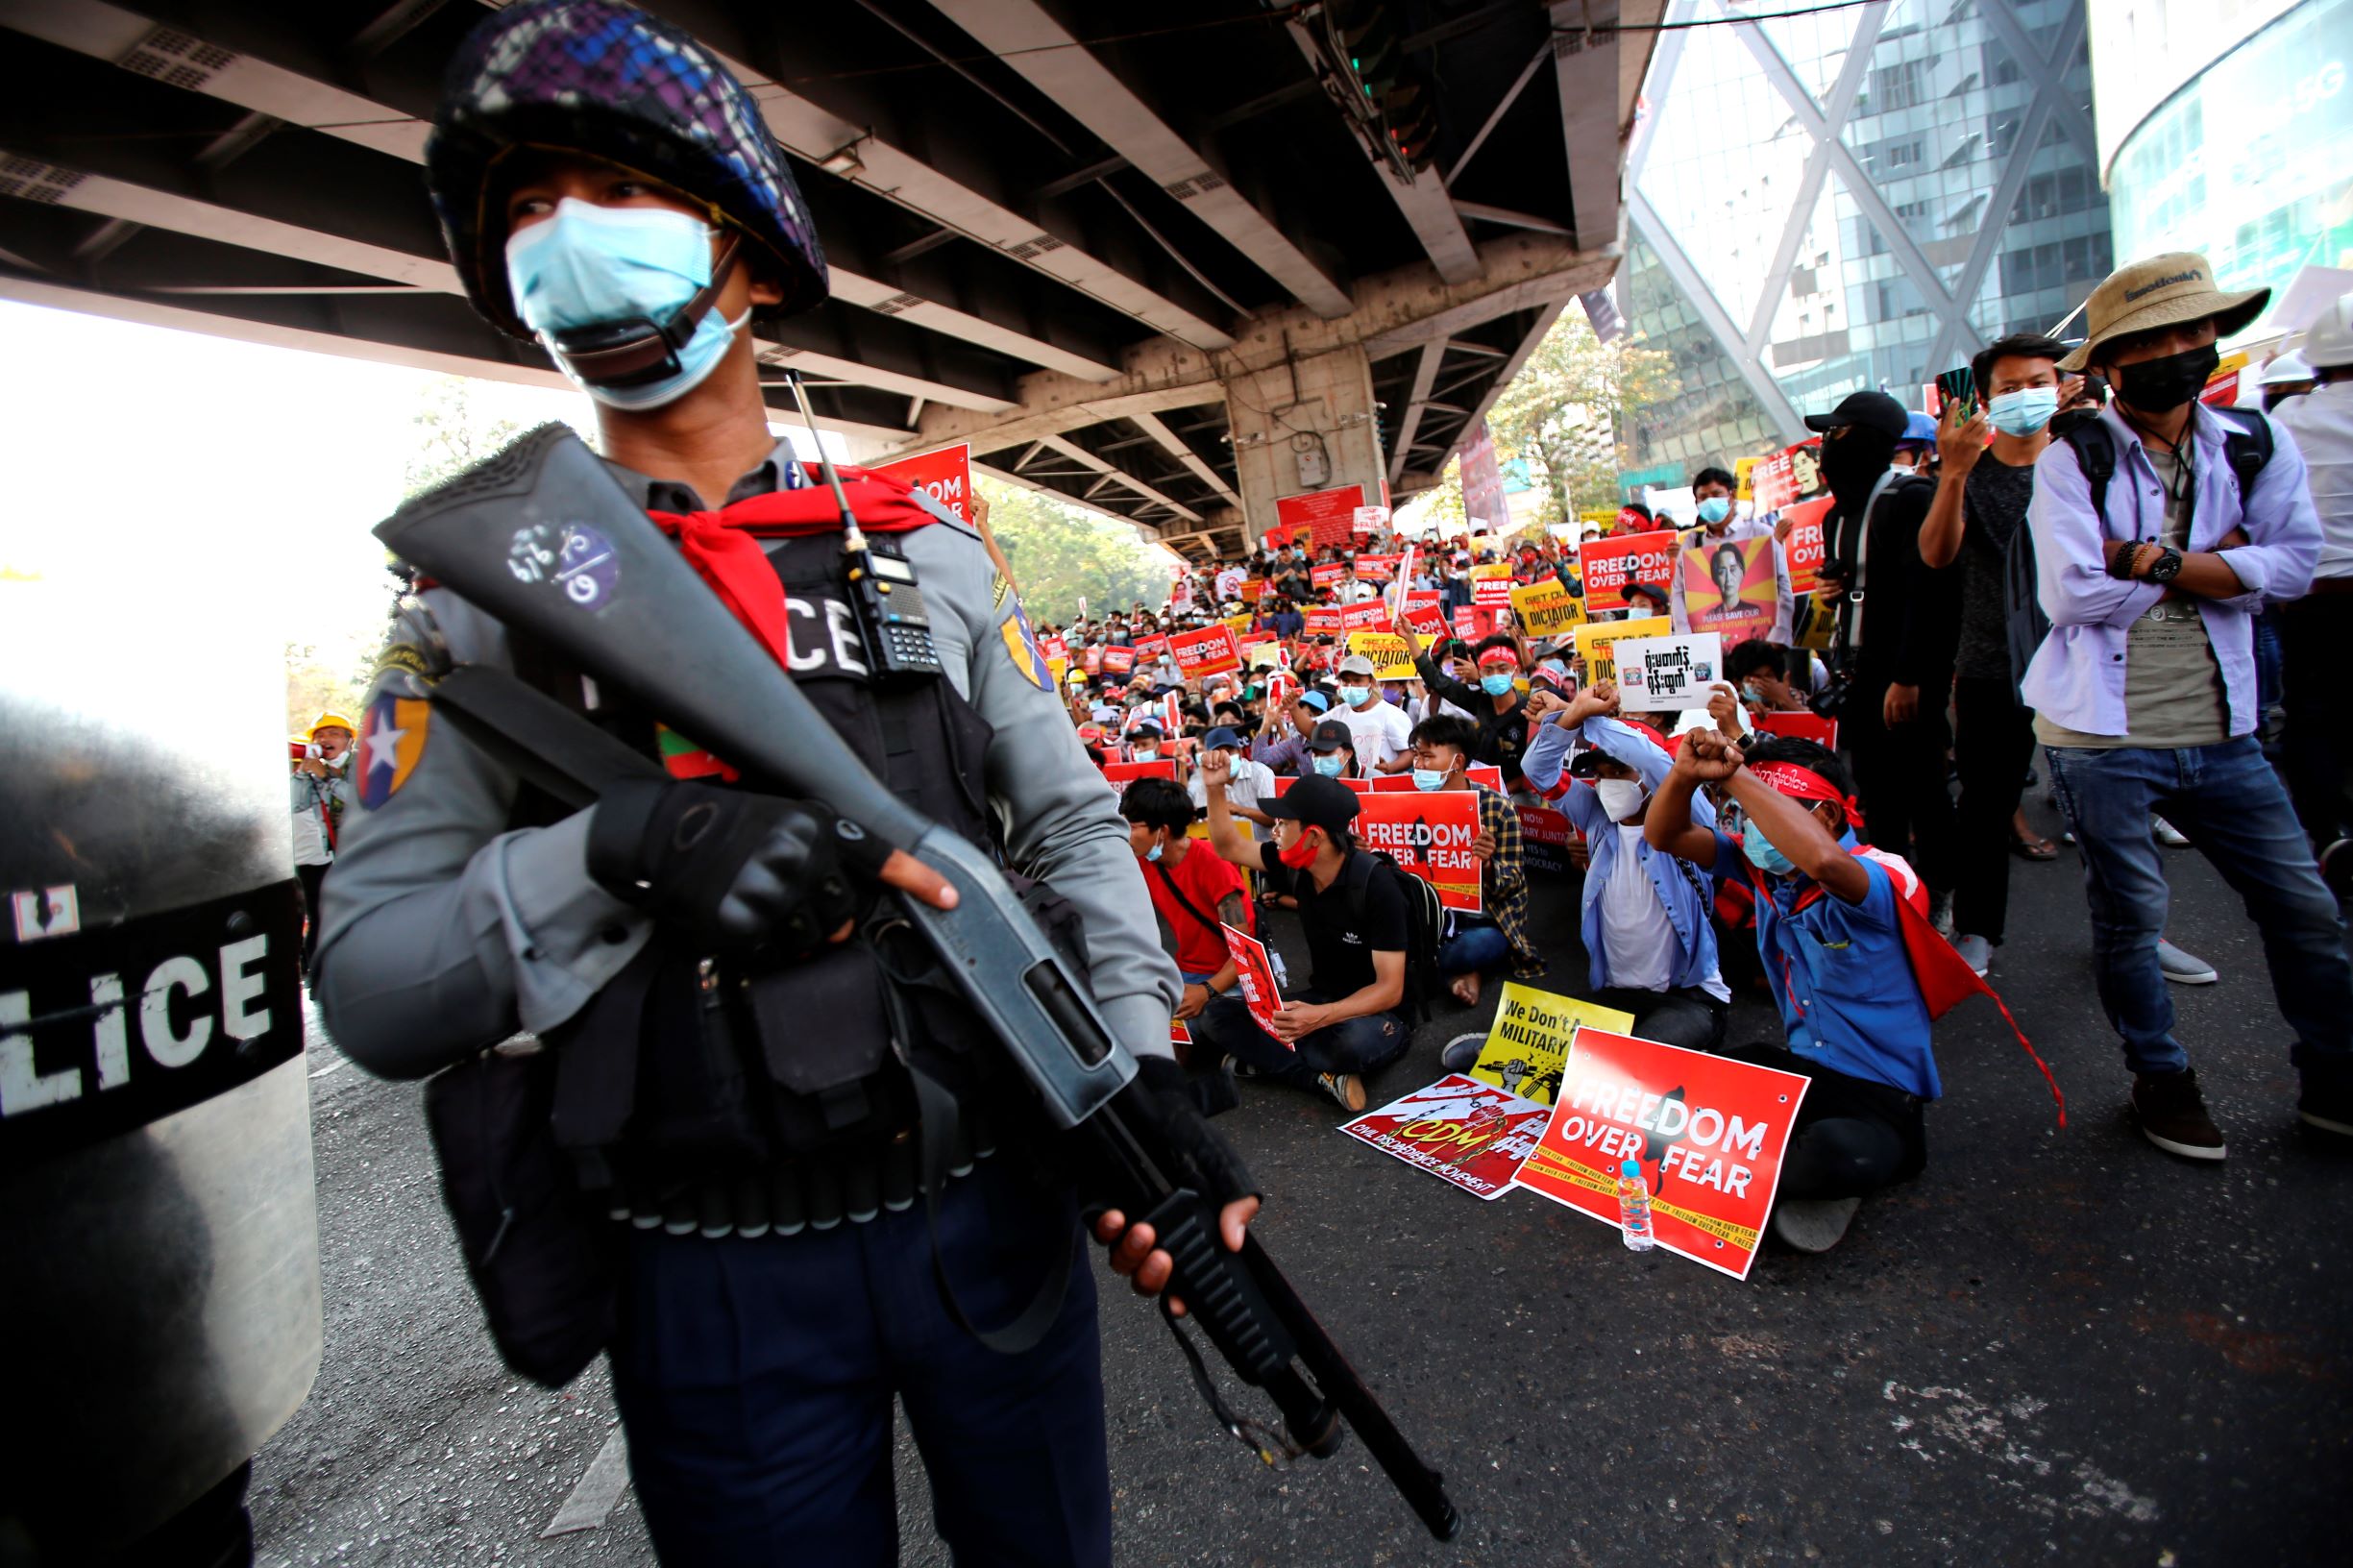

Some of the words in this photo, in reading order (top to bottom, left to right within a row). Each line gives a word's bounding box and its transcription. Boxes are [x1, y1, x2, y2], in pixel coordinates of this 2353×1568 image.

[1588, 551, 1670, 576] FREEDOM
[1476, 580, 1507, 591] FREE
[1589, 573, 1626, 588] OVER
[1635, 567, 1670, 583] FEAR
[1345, 607, 1384, 621] FREEDOM
[1345, 619, 1363, 628] OVER
[1530, 603, 1579, 626] DICTATOR
[1726, 611, 1743, 620] SAVE
[1744, 608, 1759, 617] OUR
[1175, 637, 1227, 657] FREEDOM
[1179, 655, 1202, 666] OVER
[1205, 647, 1230, 660] FEAR
[1360, 649, 1410, 666] DICTATOR
[1524, 813, 1535, 823] NO
[1535, 816, 1544, 824] to
[1366, 822, 1472, 847] FREEDOM
[1427, 849, 1472, 870] FEAR
[1523, 854, 1562, 872] MOCRACY
[0, 932, 273, 1117] LICE
[1505, 998, 1526, 1019] We
[1529, 1005, 1569, 1033] Don't
[1500, 1021, 1569, 1057] MILITARY
[1572, 1080, 1769, 1161] FREEDOM
[1403, 1119, 1491, 1154] CDM
[1352, 1124, 1379, 1139] CIVIL
[1436, 1162, 1496, 1192] MOVEMENT
[1539, 1147, 1551, 1157] OVER
[1551, 1153, 1563, 1163] FEAR
[1567, 1160, 1588, 1174] FREEDOM
[1588, 1168, 1602, 1180] OVER
[1602, 1174, 1615, 1186] FEAR
[1561, 1115, 1643, 1160] OVER
[1659, 1143, 1753, 1199] FEAR
[1544, 1165, 1557, 1176] OVER
[1558, 1170, 1572, 1181] FEAR
[1576, 1175, 1598, 1189] FREEDOM
[1599, 1183, 1612, 1194] OVER
[1655, 1199, 1670, 1212] FEAR
[1672, 1208, 1697, 1224] FREEDOM
[1698, 1217, 1714, 1232] OVER
[1714, 1226, 1729, 1239] FEAR
[1724, 1221, 1738, 1234] OVER
[1741, 1228, 1757, 1239] FEAR
